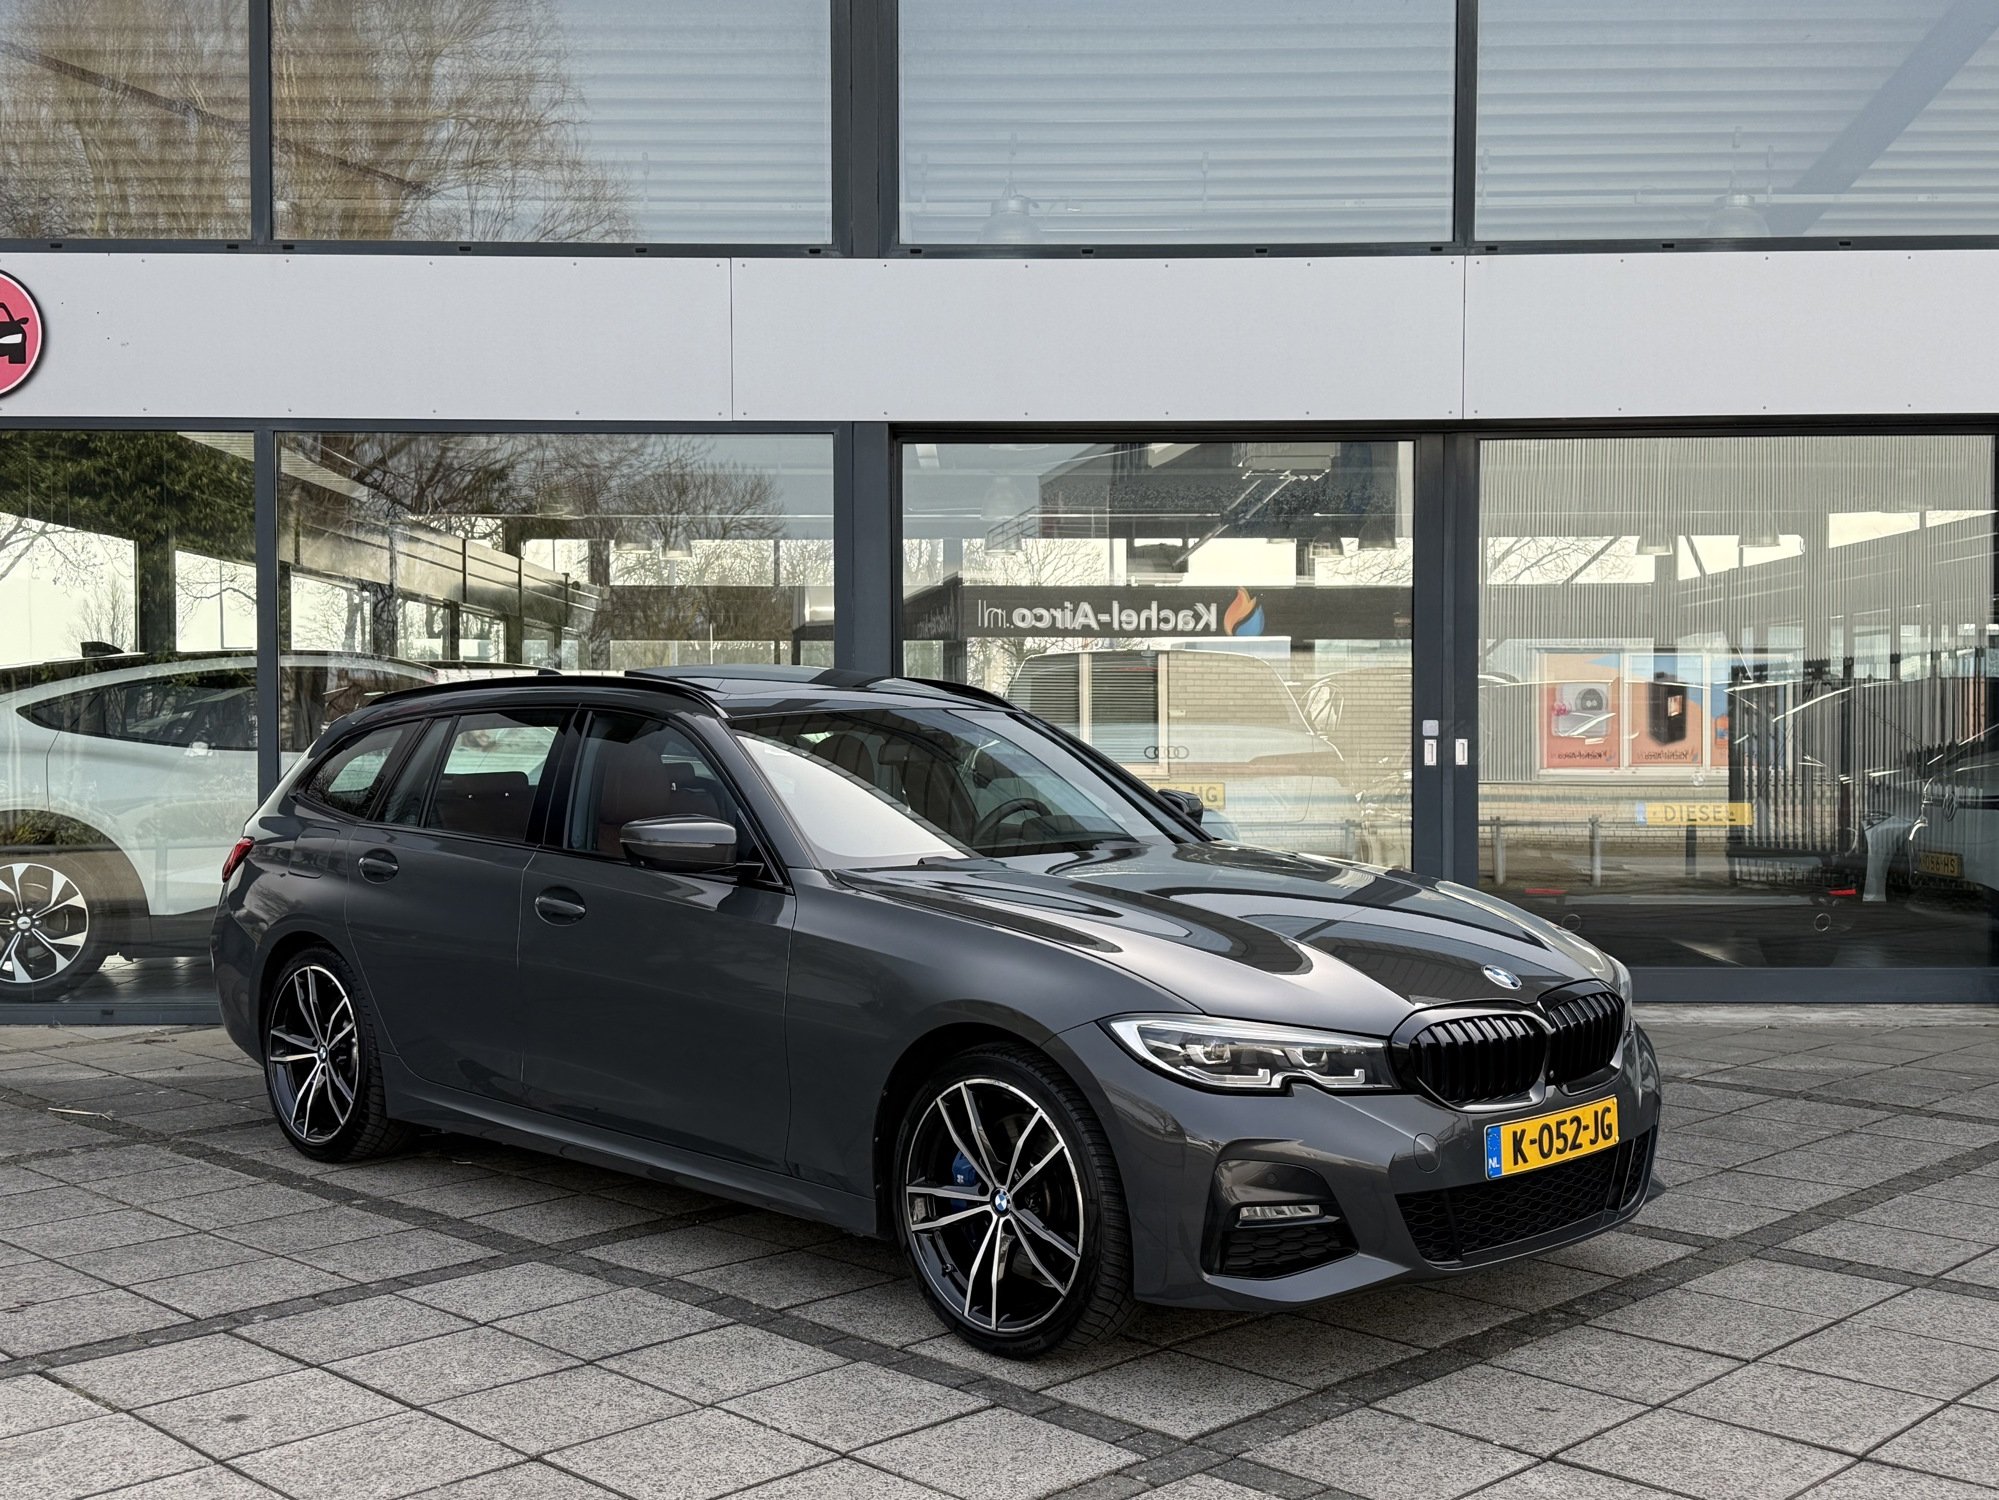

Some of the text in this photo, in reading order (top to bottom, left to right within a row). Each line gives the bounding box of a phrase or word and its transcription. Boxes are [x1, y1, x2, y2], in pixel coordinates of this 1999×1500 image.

[1664, 805, 1736, 822] DIESEL
[1513, 1106, 1613, 1166] K-052-JG
[1488, 1156, 1501, 1169] NL
